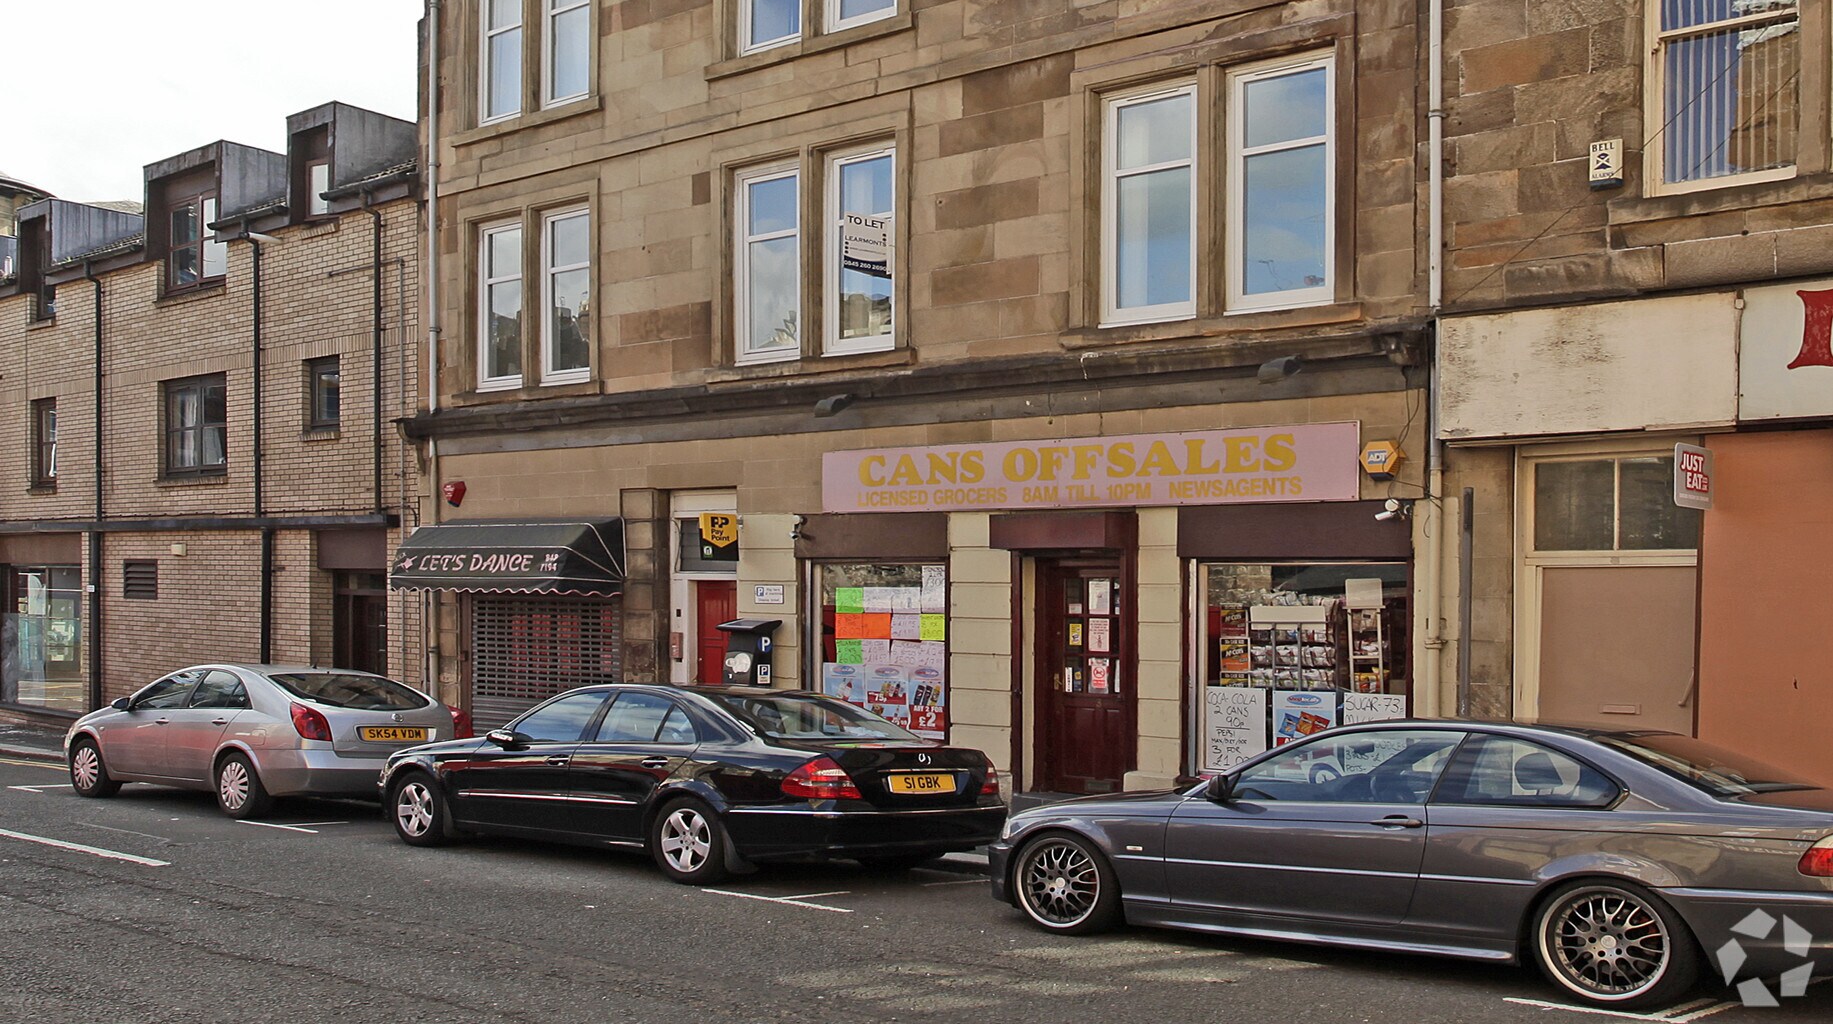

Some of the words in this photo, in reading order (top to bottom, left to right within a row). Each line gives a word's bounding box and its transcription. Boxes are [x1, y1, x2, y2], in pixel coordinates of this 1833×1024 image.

[1592, 142, 1615, 152] BELL
[847, 215, 862, 225] TO
[865, 218, 885, 229] LET
[858, 450, 986, 487] CANS
[1002, 433, 1297, 482] OFFSALES
[1368, 453, 1386, 462] ADT
[1681, 453, 1704, 473] JUST
[1686, 471, 1703, 490] EAT
[857, 489, 929, 507] LICENSED
[933, 486, 1008, 505] GROCERS
[1022, 485, 1059, 503] 8AM
[1066, 484, 1099, 502] TILL
[1107, 482, 1151, 501] 10PM
[1168, 476, 1303, 499] NEWSAGENTS
[711, 534, 730, 542] Point
[418, 554, 467, 572] LET'S
[469, 553, 534, 573] DANCE
[1214, 705, 1222, 715] 2
[1226, 706, 1249, 717] CANS
[919, 712, 937, 727] £2
[1226, 716, 1244, 728] 90p
[368, 728, 398, 739] SK54
[400, 728, 422, 738] VDM
[1216, 729, 1236, 737] PEPSI
[1212, 745, 1222, 754] 3
[918, 777, 941, 788] GBK
